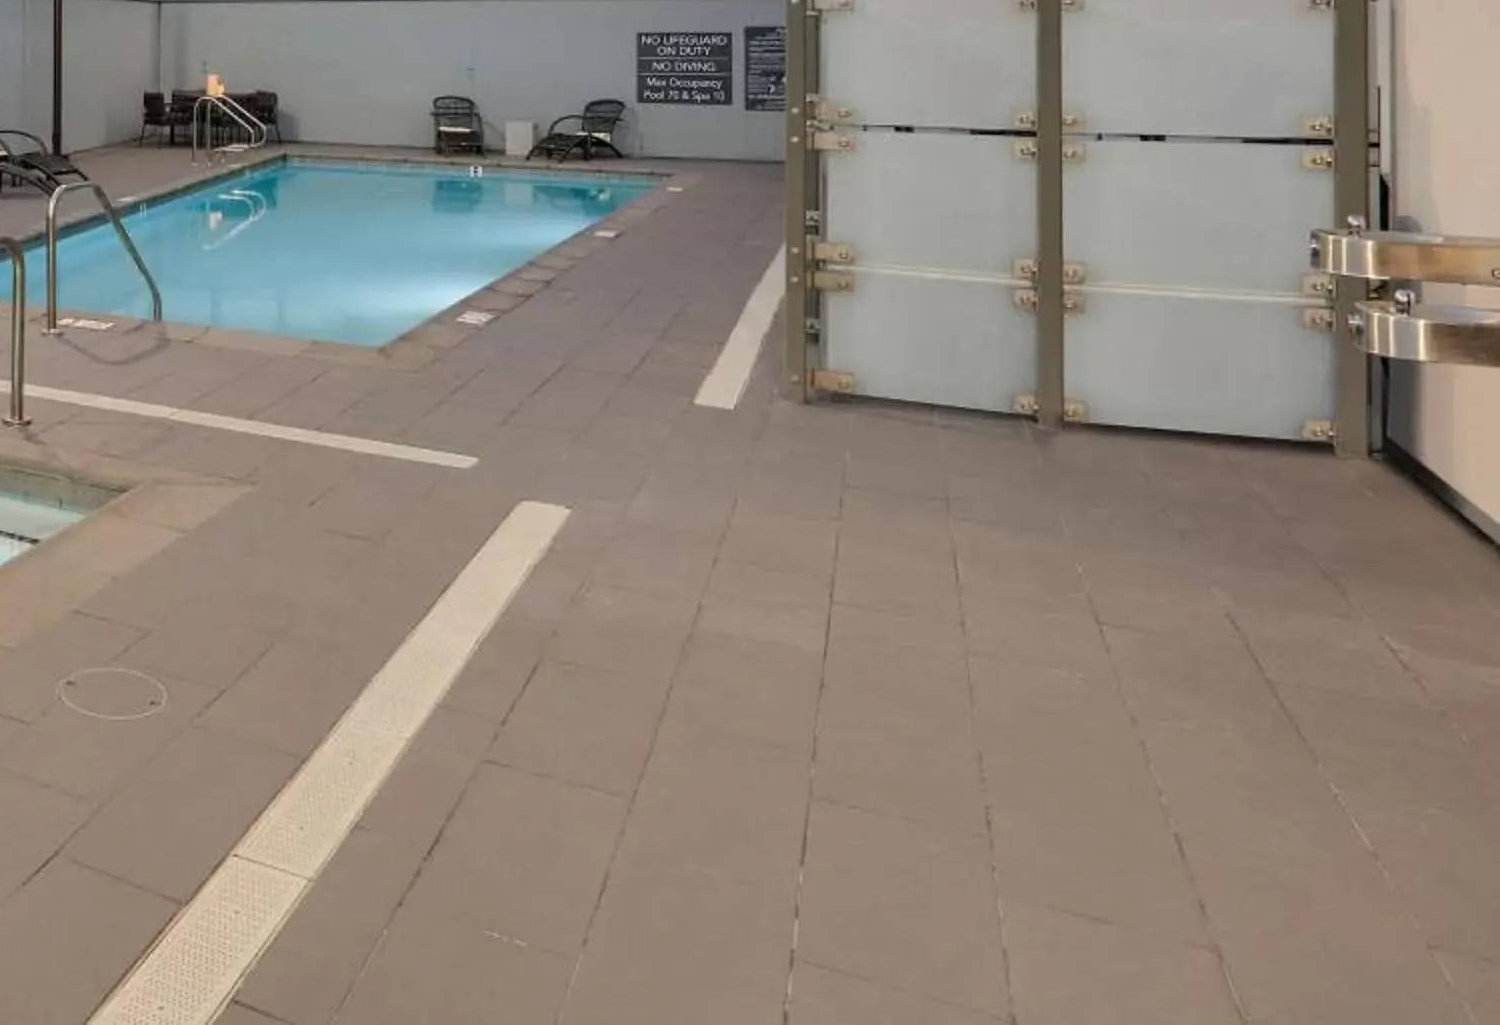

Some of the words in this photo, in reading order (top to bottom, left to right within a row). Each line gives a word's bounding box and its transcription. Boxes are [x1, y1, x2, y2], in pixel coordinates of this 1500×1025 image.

[641, 34, 661, 47] NO
[663, 34, 728, 46] LIFEGUARD
[657, 46, 677, 56] ON
[680, 46, 711, 56] DUTY
[652, 61, 671, 72] NO
[675, 61, 717, 72] DIVING
[647, 77, 667, 87] Max
[669, 77, 723, 90] Occupancy
[644, 90, 665, 100] Pool
[692, 90, 711, 103] Spa
